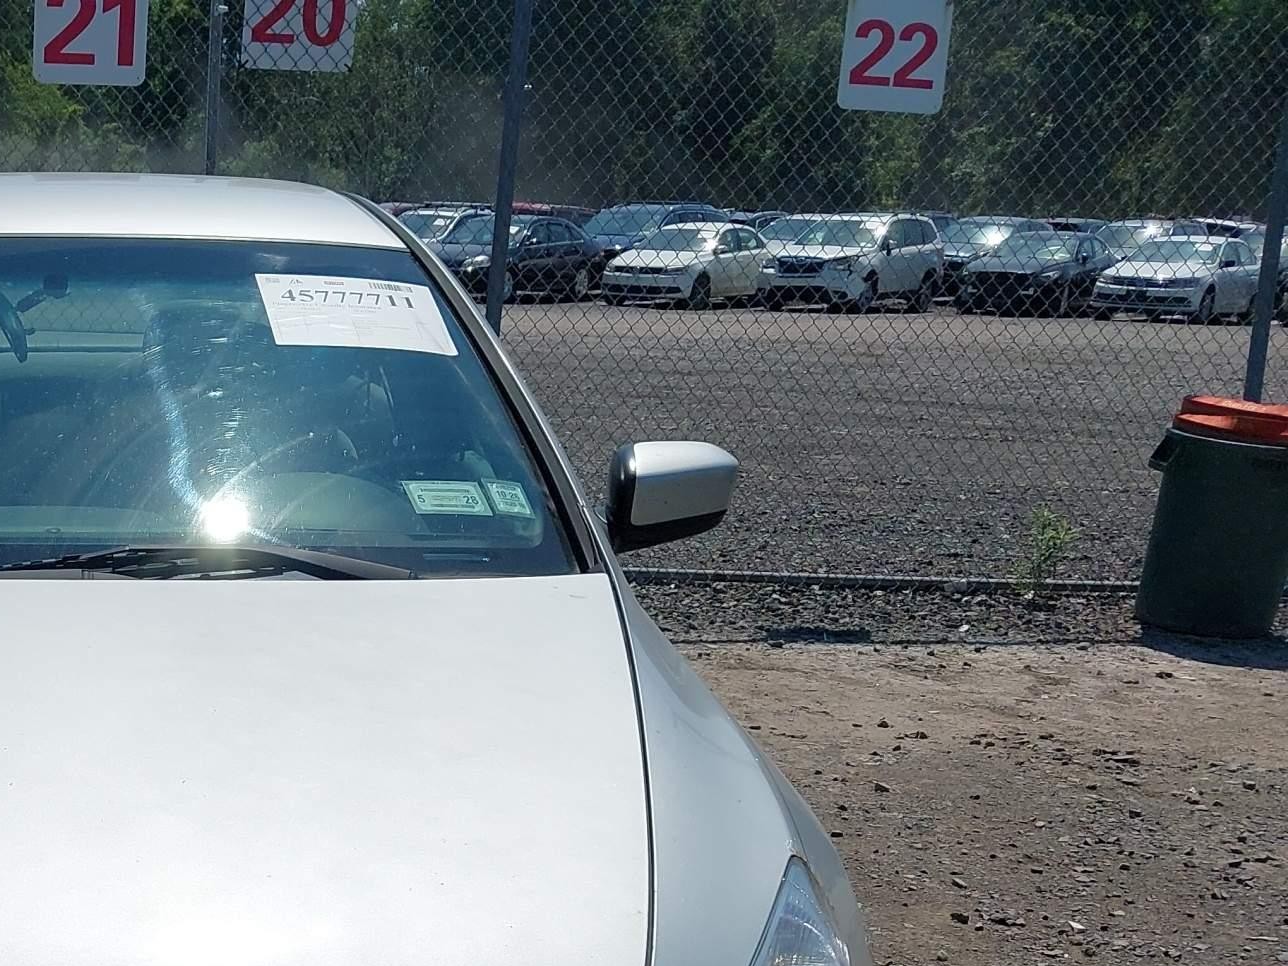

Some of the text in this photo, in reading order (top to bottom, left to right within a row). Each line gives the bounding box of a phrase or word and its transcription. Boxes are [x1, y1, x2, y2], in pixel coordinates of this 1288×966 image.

[43, 0, 136, 66] 21
[251, 0, 346, 46] 20
[849, 19, 938, 90] 22
[280, 288, 416, 309] 45777711
[417, 494, 426, 504] 5
